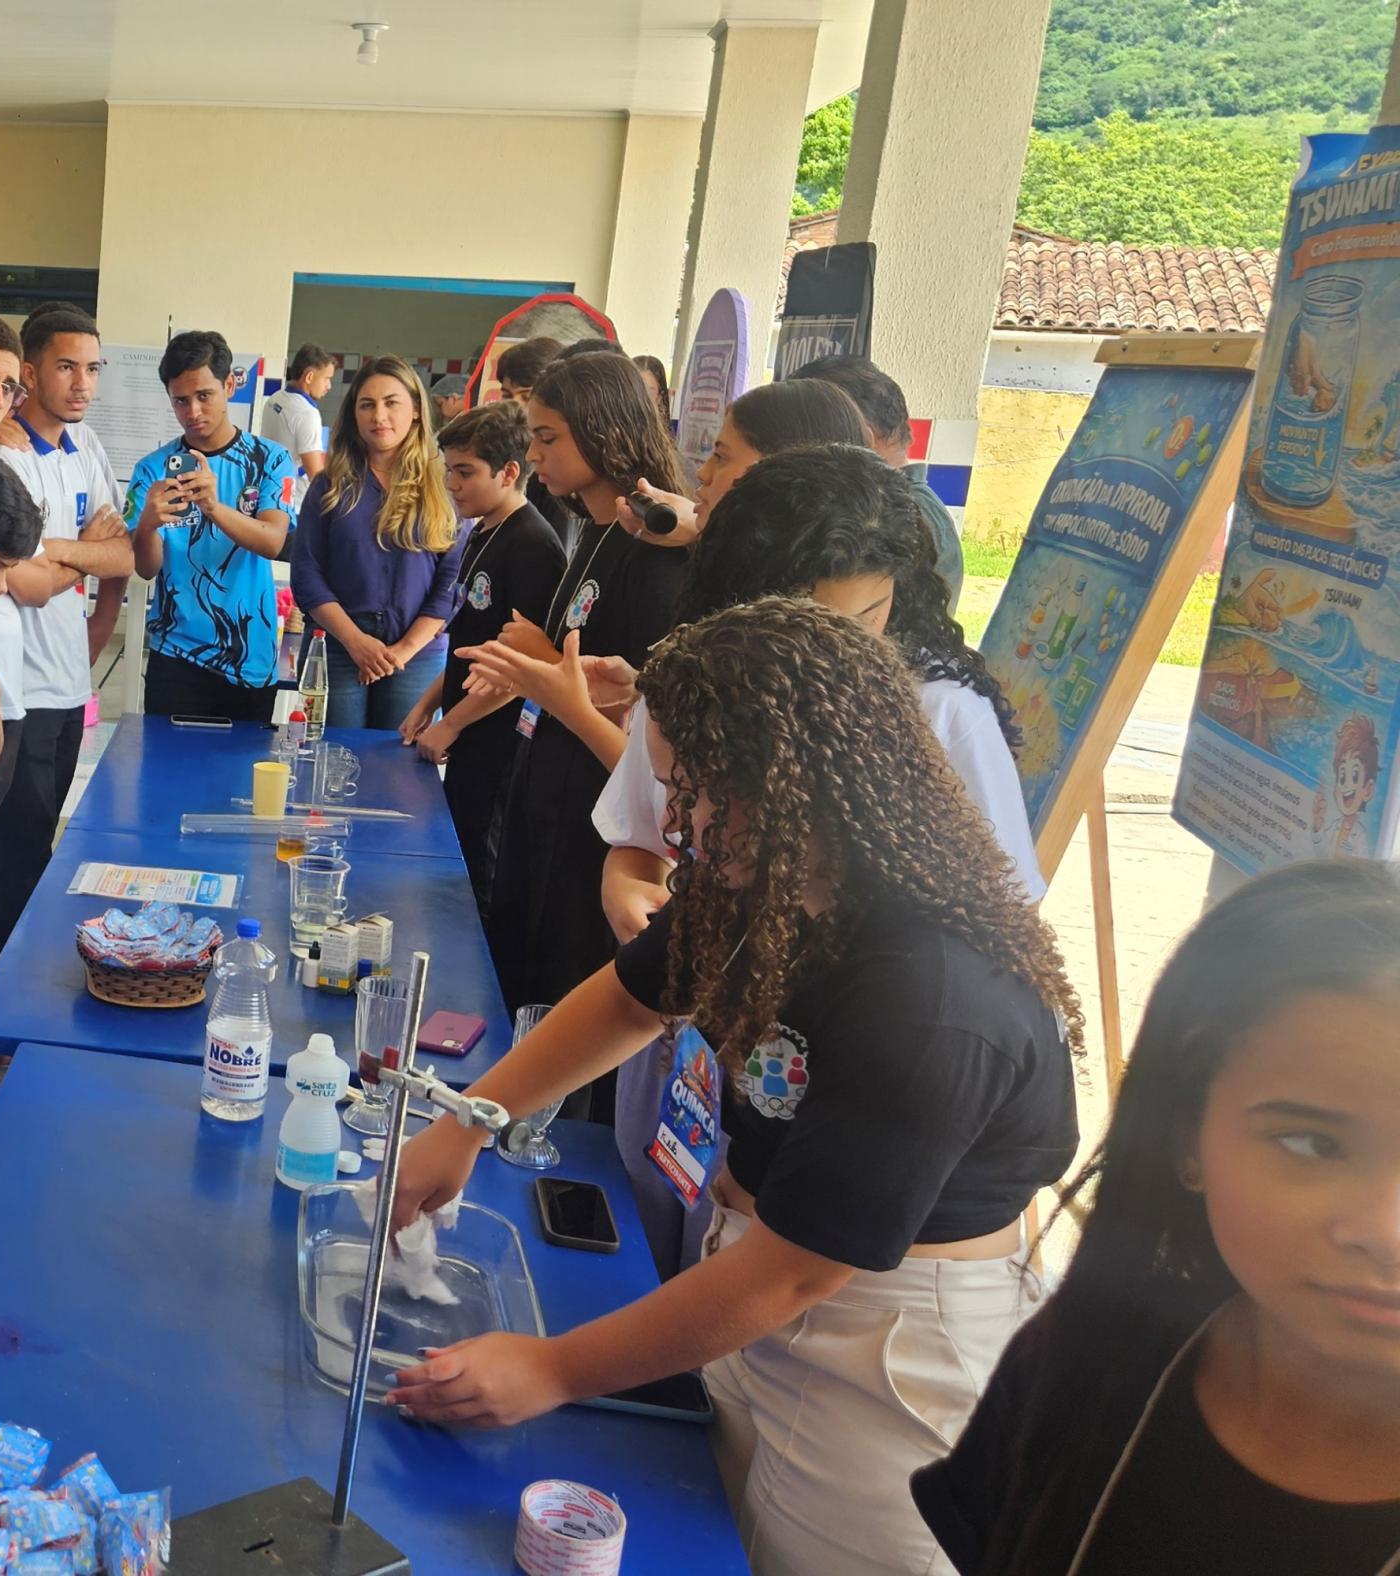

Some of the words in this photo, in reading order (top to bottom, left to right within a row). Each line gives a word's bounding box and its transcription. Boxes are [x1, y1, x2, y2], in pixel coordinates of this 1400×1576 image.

[1299, 171, 1397, 233] TSUNAMI
[1109, 481, 1171, 536] DIPIRONA
[1053, 513, 1111, 545] HIPOCLORITO
[1105, 529, 1120, 548] DE
[1115, 528, 1150, 563] SÓDIO
[1324, 588, 1362, 610] TSUNAMI
[311, 1089, 336, 1098] cruz
[312, 1080, 337, 1090] santa
[671, 1078, 715, 1141] QUÍMICA
[656, 1147, 692, 1195] PARTICIPANTE
